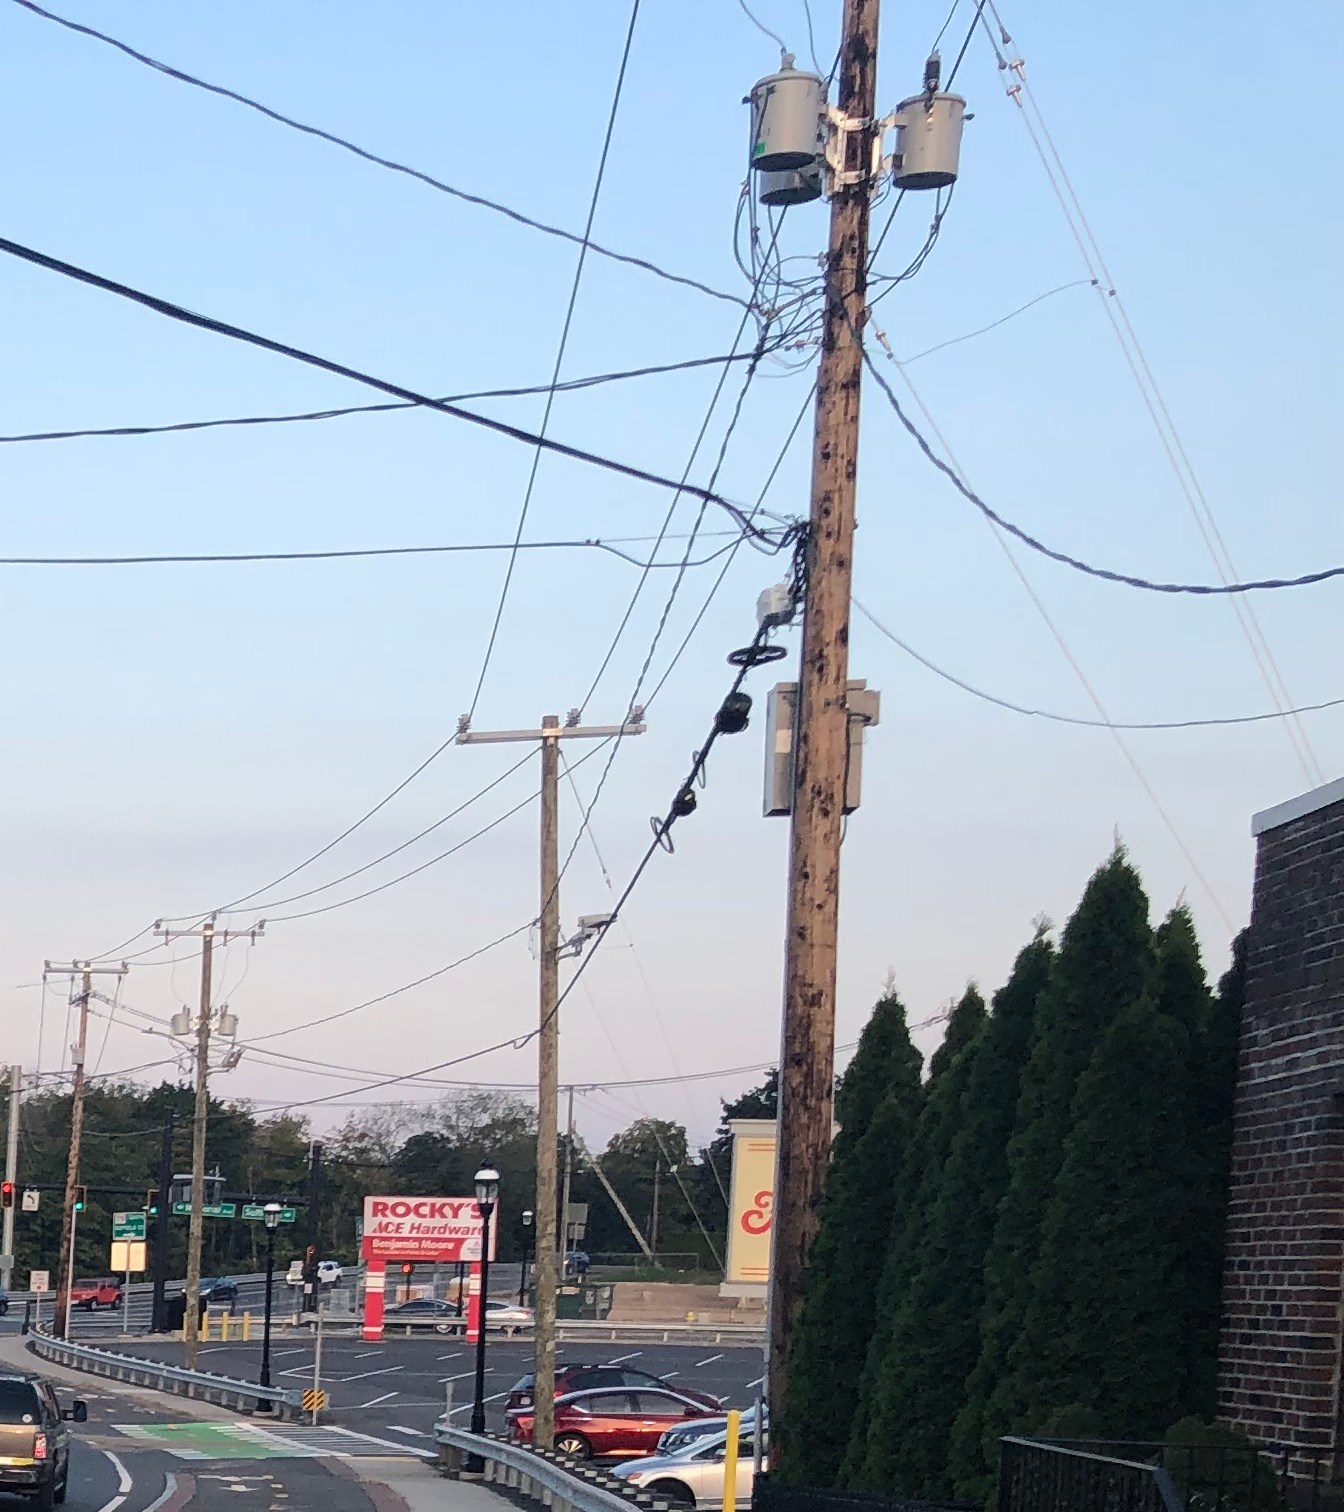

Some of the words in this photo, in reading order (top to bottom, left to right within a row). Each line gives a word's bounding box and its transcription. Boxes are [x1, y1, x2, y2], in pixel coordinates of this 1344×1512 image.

[372, 1201, 482, 1219] ROCKY'S
[372, 1220, 405, 1233] ACE
[372, 1239, 419, 1250] Benjamin
[421, 1240, 455, 1249] Moore
